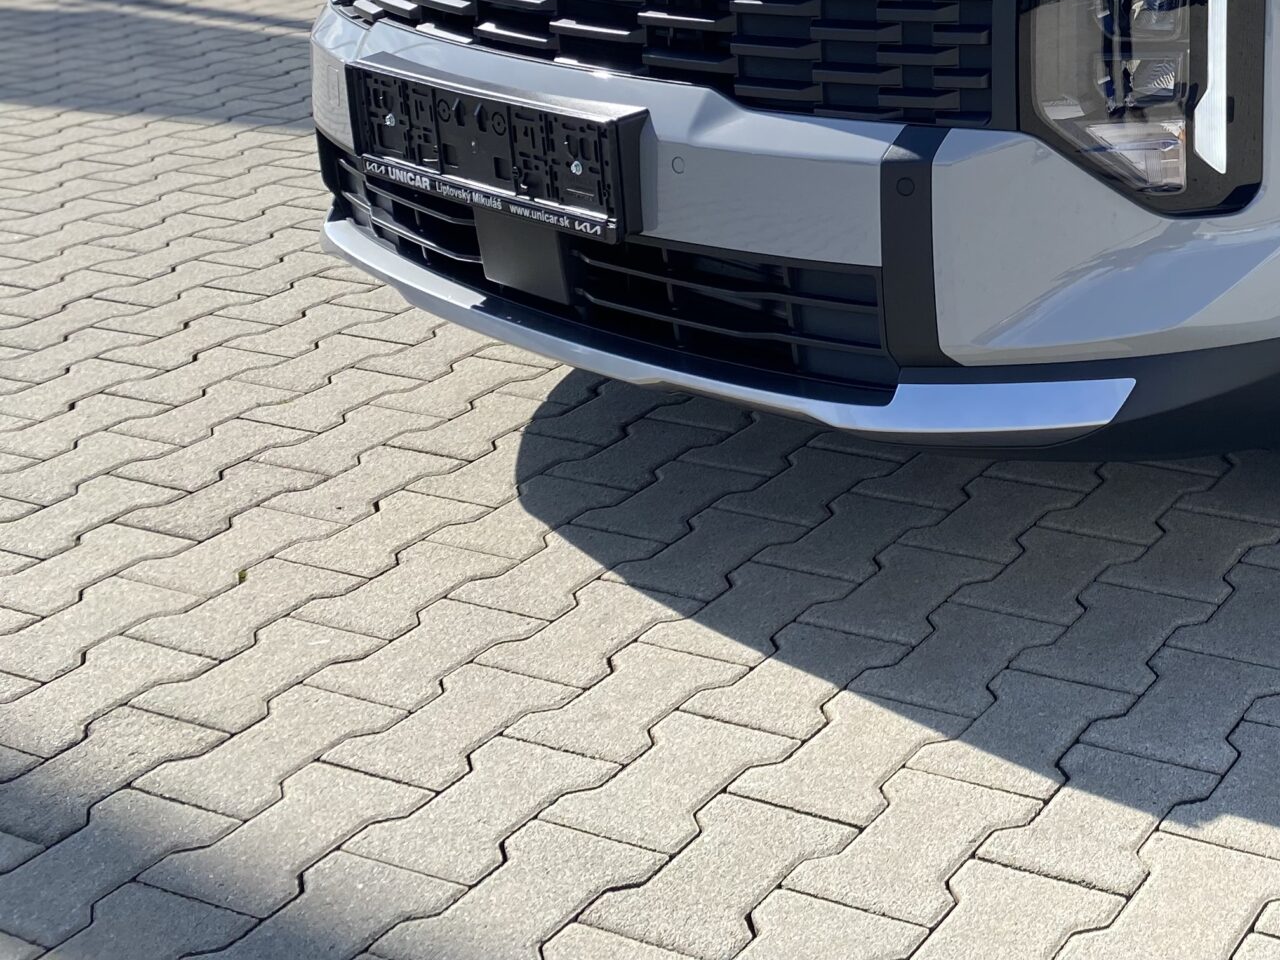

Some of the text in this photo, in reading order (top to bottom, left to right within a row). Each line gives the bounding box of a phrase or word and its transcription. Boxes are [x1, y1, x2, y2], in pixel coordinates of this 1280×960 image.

[366, 161, 601, 236] KIA UNICAR Liptovský Mikuláš www.unicar.sk KIA
